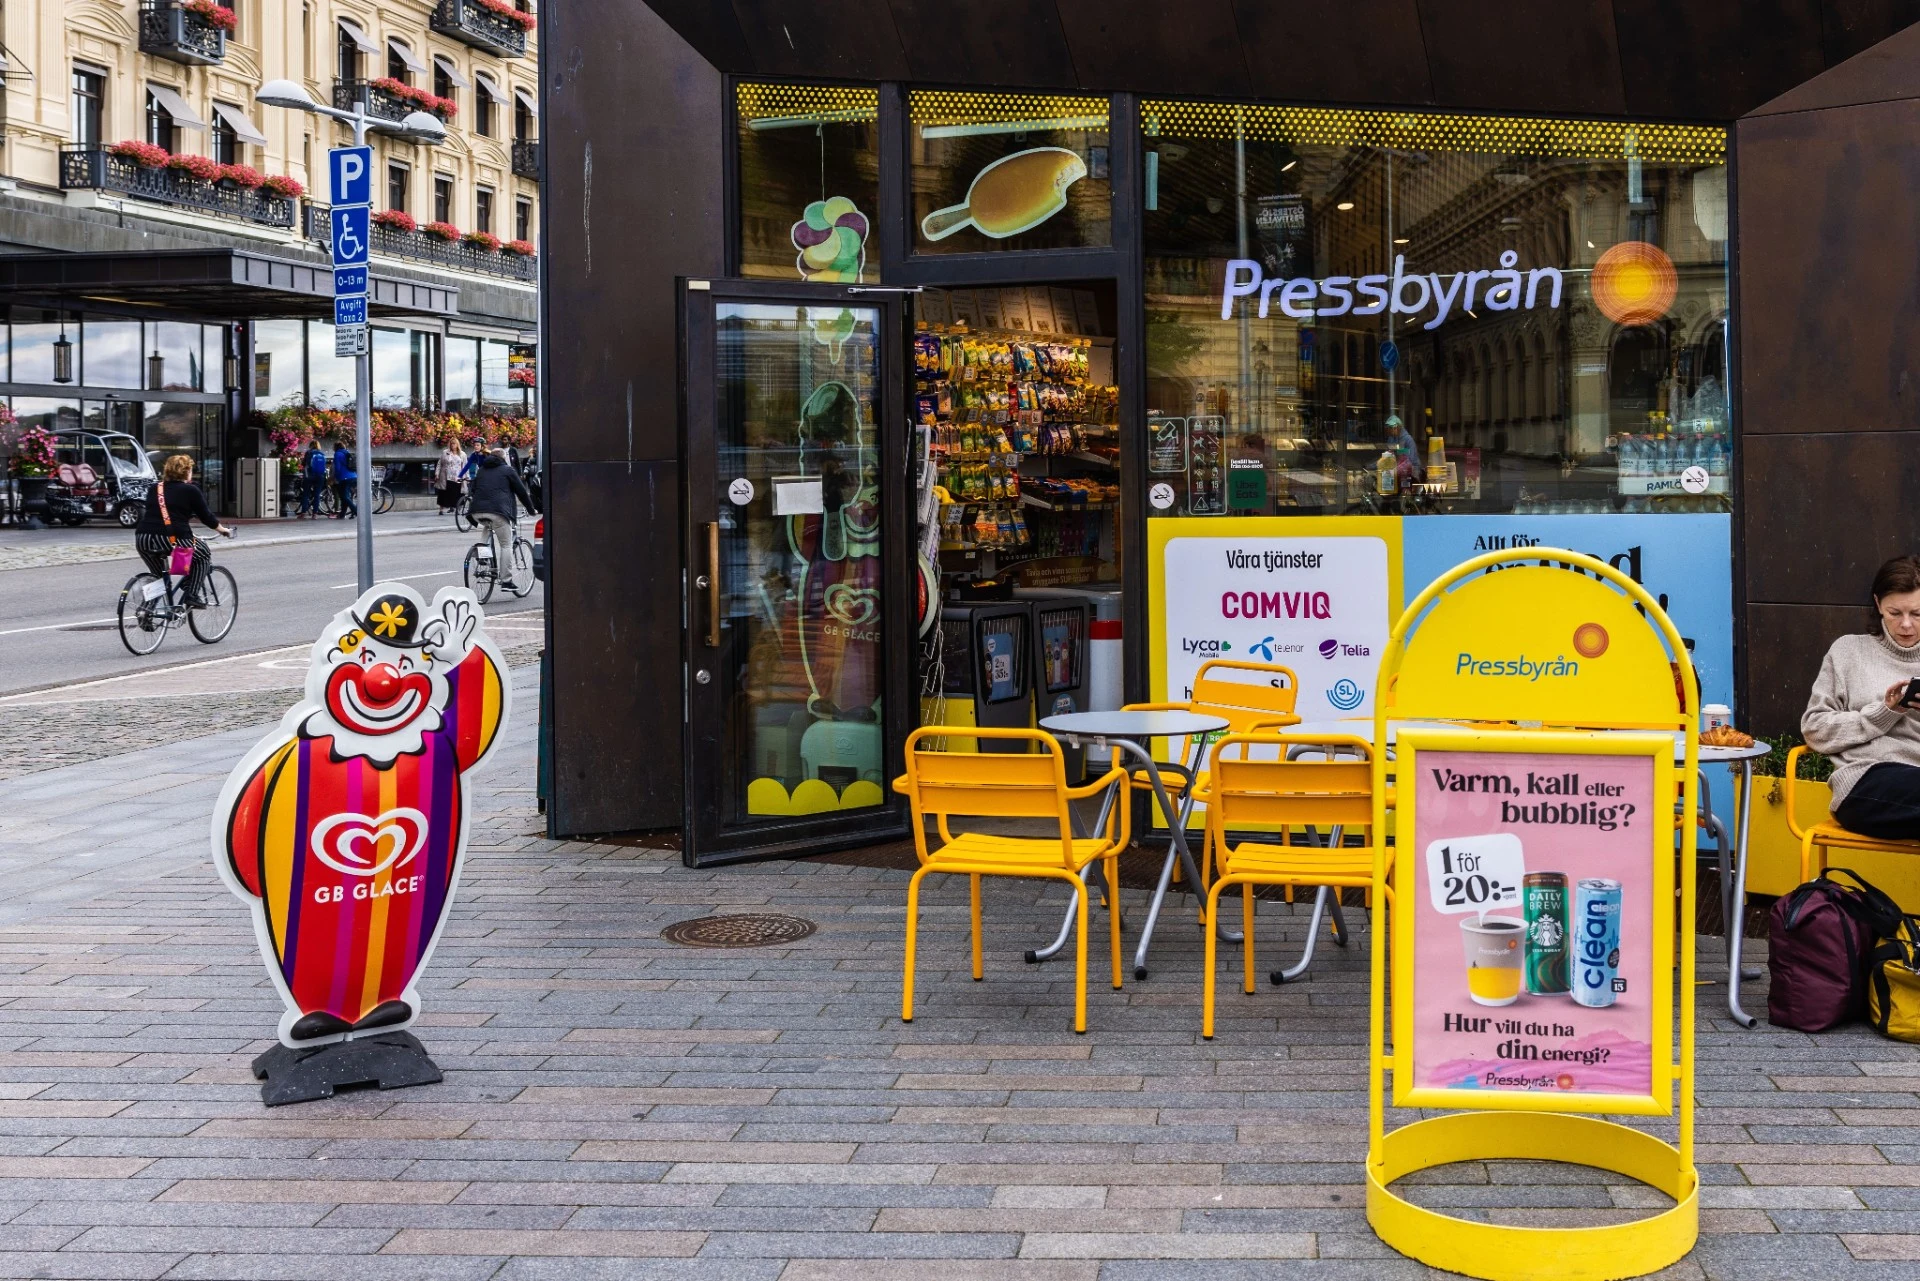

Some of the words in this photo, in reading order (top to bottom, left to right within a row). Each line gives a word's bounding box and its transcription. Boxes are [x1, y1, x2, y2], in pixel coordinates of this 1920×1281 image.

[340, 153, 364, 200] P
[356, 276, 364, 285] m
[1221, 249, 1563, 331] Pressbyrån
[340, 299, 362, 311] Avgift
[339, 313, 356, 323] Taxa
[357, 311, 363, 322] 2
[1646, 478, 1682, 492] RAMLÖ
[1473, 535, 1506, 550] Allt
[1511, 534, 1541, 548] för
[1226, 549, 1261, 569] Våra
[1263, 550, 1324, 573] tjänster
[1222, 591, 1332, 620] COMVIQ
[823, 624, 838, 636] GB
[842, 627, 881, 642] GLACE
[1182, 637, 1220, 654] Lyca
[1274, 643, 1305, 653] telenor
[1341, 644, 1370, 656] Telia
[1456, 652, 1579, 682] Pressbyrån
[1338, 685, 1353, 696] SL
[1431, 768, 1521, 797] Varm,
[1526, 772, 1580, 796] kall
[1584, 782, 1626, 797] eller
[1501, 800, 1636, 832] bubblig?
[1440, 845, 1454, 875] 1
[1456, 852, 1482, 873] för
[314, 885, 345, 904] GB
[352, 875, 420, 901] GLACE
[1443, 873, 1516, 906] 20:-
[1529, 892, 1562, 901] DAILY
[1529, 901, 1562, 911] BREW
[1579, 899, 1608, 990] clean
[1614, 983, 1625, 992] 15
[1443, 1012, 1493, 1034] Hur
[1494, 1018, 1521, 1035] vill
[1524, 1021, 1549, 1036] du
[1552, 1022, 1575, 1037] ha
[1496, 1038, 1539, 1061] din
[1541, 1046, 1611, 1066] energi?
